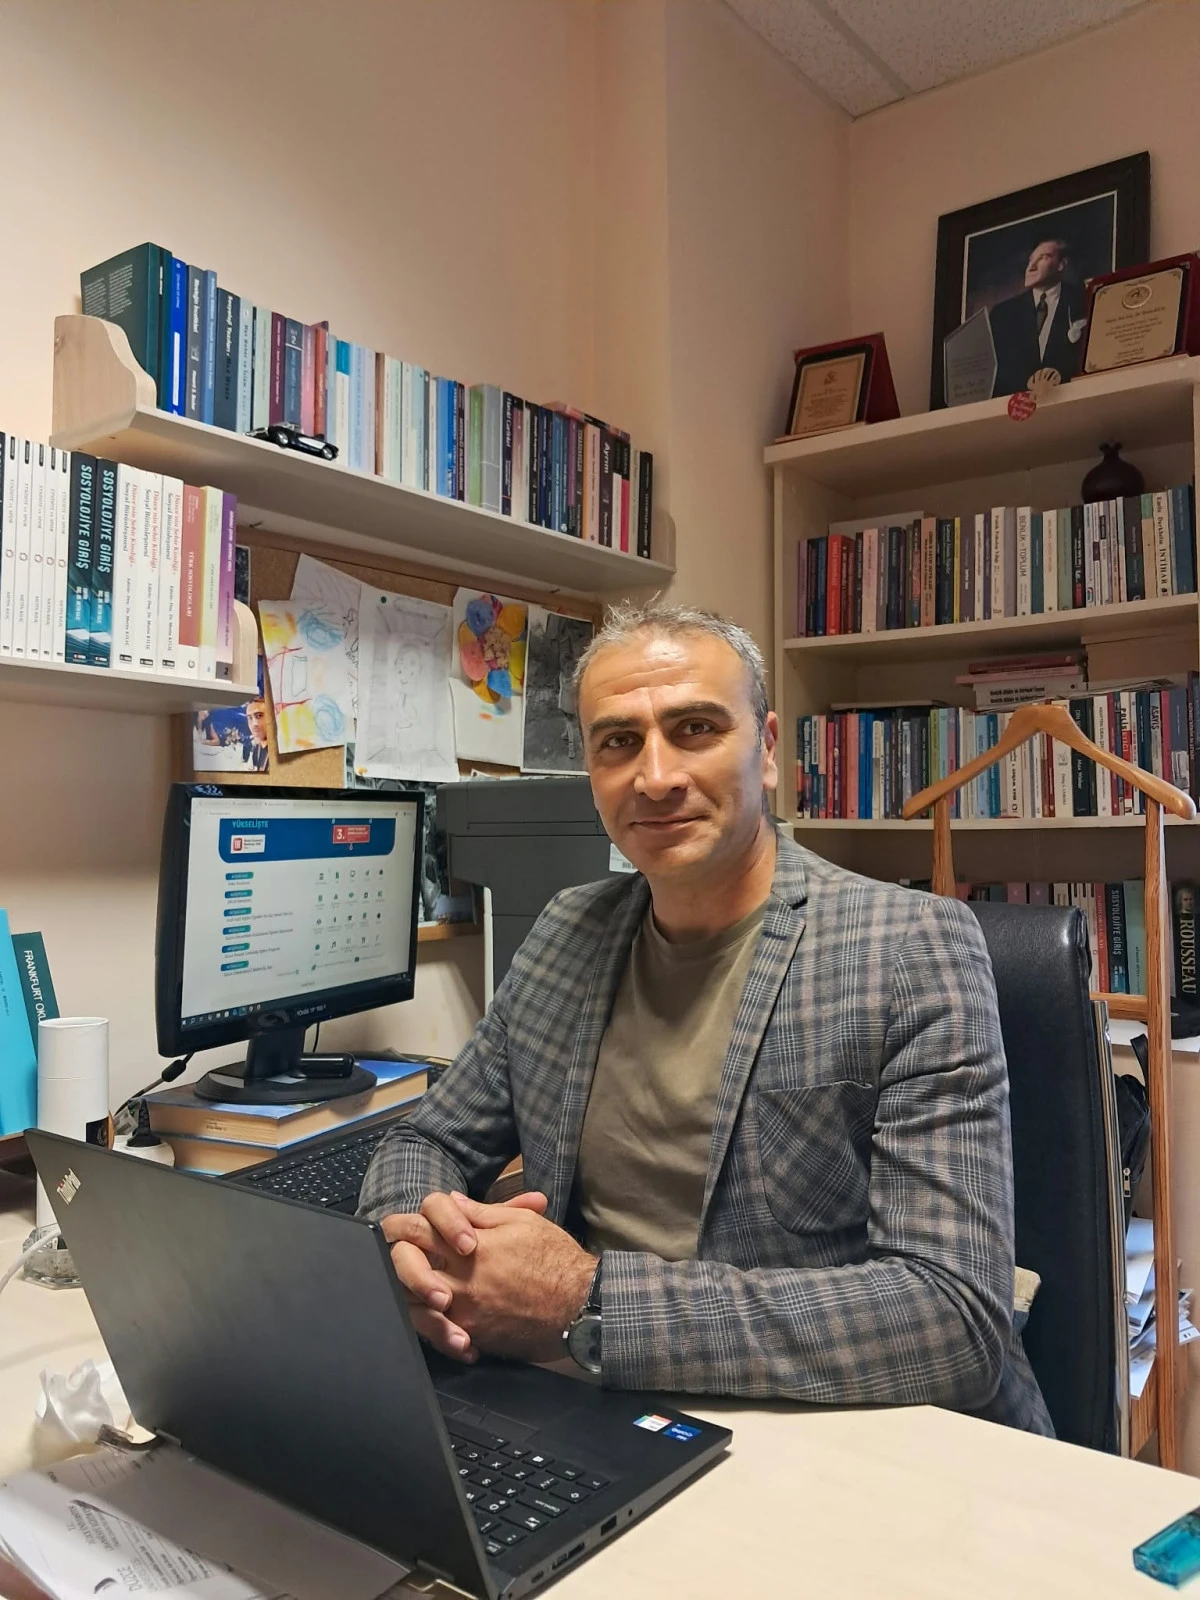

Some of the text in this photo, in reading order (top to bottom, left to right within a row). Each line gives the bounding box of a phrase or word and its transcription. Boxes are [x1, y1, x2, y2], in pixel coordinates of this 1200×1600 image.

[603, 442, 611, 474] Ayrım
[75, 464, 93, 569] SOSYOLOJİYE GİRİŞ
[97, 470, 115, 573] SOSYOLOJİYE GİRİŞ
[122, 482, 131, 552] Sosyal Bütünleşmesi
[129, 519, 137, 537] Şehir
[143, 489, 152, 557] Sosyal Bütünleşmesi
[151, 525, 159, 542] Şehir
[165, 492, 173, 560] Sosyal Bütünleşmesi
[1157, 517, 1165, 545] Durkheim
[172, 528, 180, 545] Şehir
[1019, 548, 1027, 577] TOPLUM
[1159, 548, 1168, 584] İNTİHAR
[1120, 708, 1129, 730] POLİS
[232, 820, 269, 830] YÜKSELİŞTE
[1111, 890, 1122, 935] SOSYOLOJİYE
[1111, 936, 1122, 955] GİRİŞ
[1179, 918, 1197, 994] ROUSSEAU
[23, 950, 43, 1002] FRANKFURT
